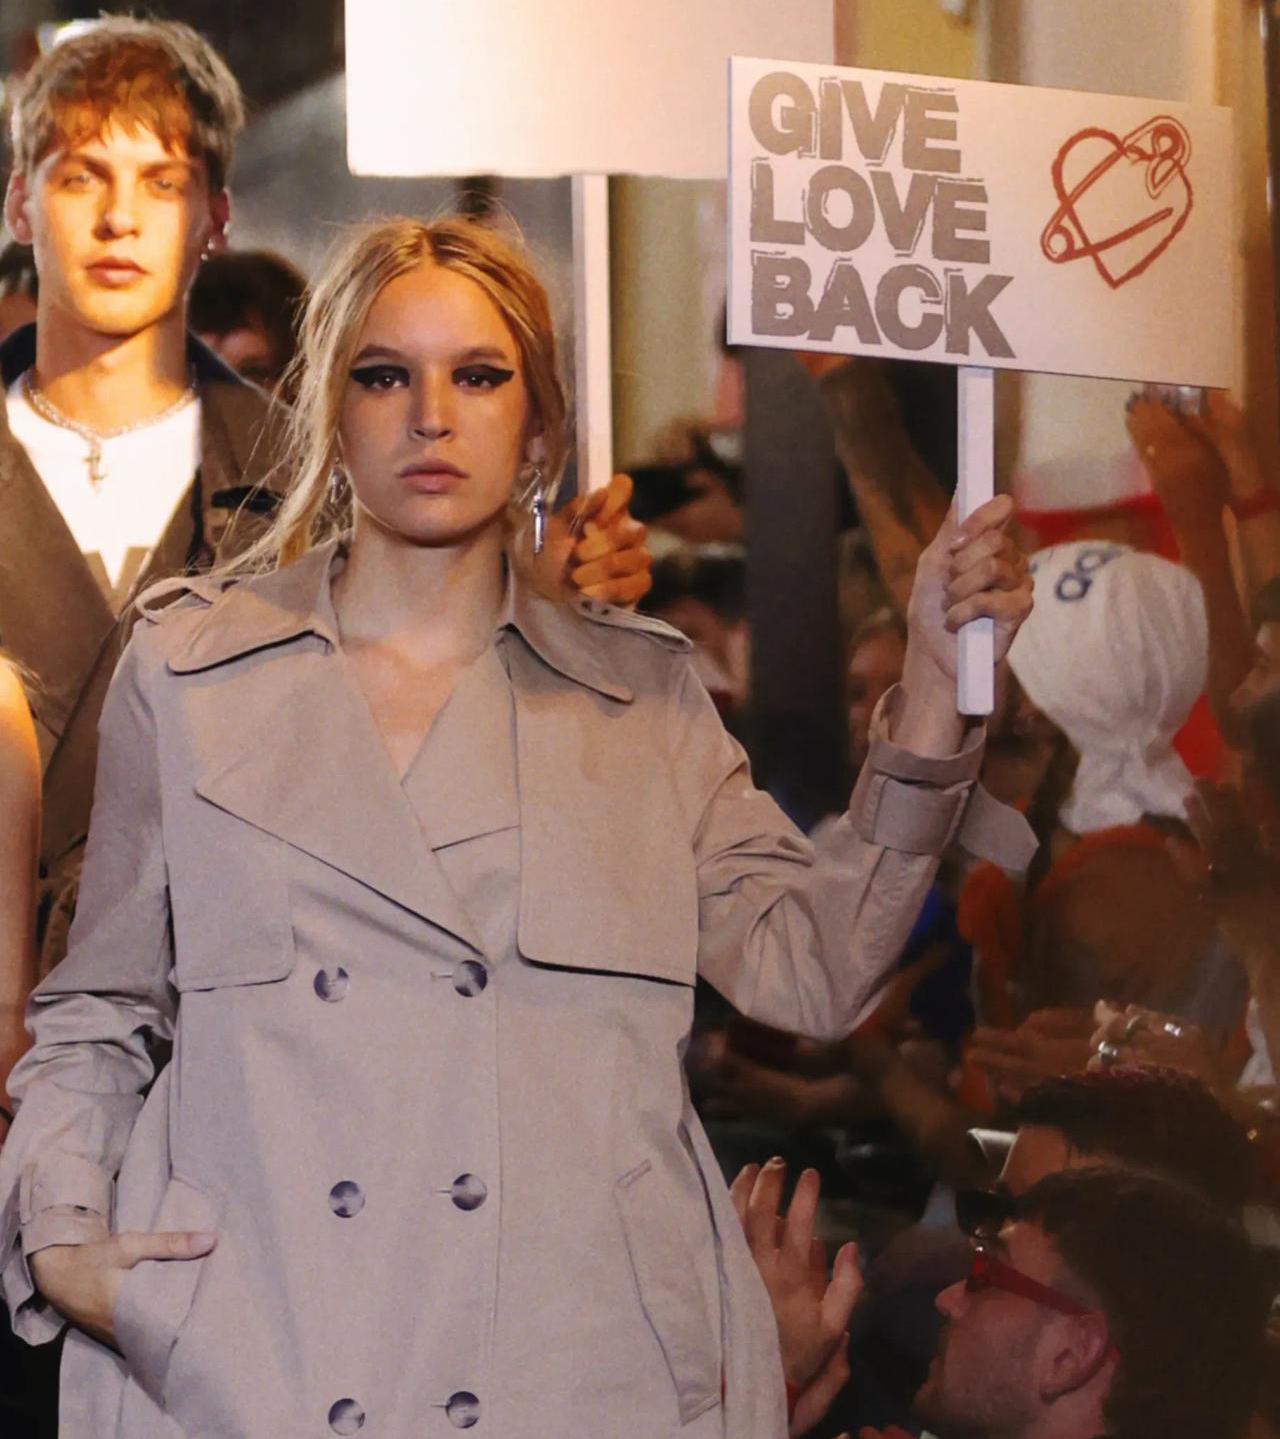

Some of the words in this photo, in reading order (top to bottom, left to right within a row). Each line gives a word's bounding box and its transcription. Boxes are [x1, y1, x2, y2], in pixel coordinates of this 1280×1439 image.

[749, 71, 962, 174] GIVE
[750, 157, 991, 264] LOVE
[751, 249, 1017, 359] BACK
